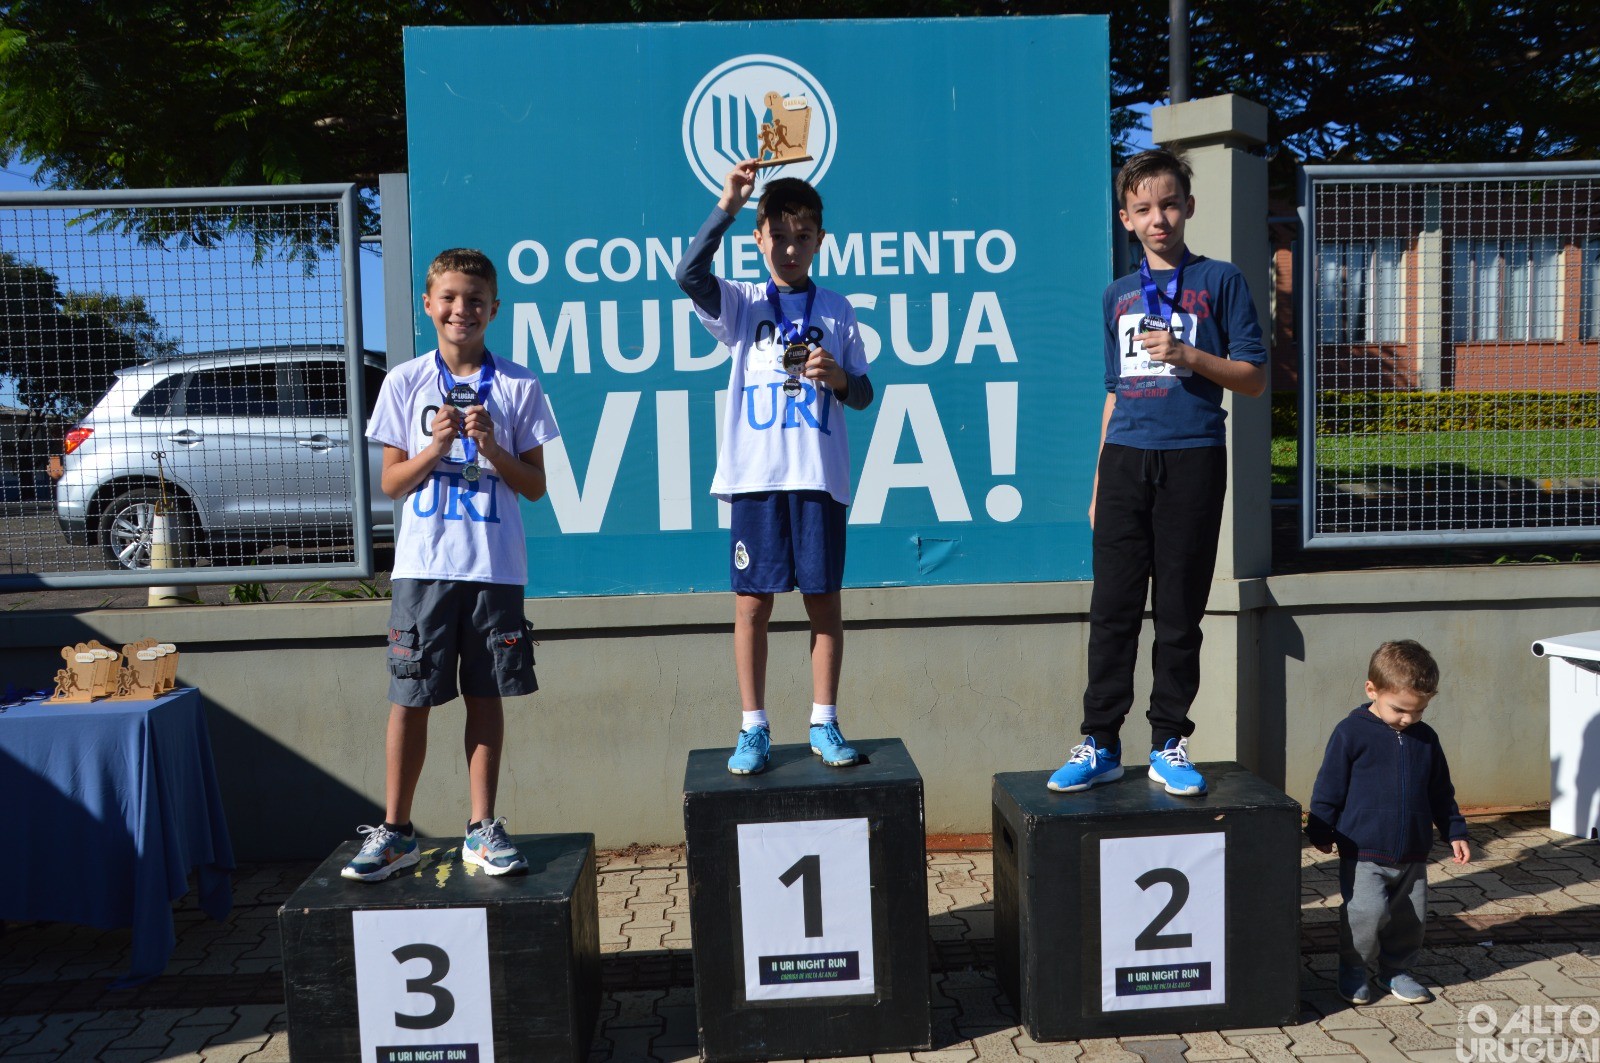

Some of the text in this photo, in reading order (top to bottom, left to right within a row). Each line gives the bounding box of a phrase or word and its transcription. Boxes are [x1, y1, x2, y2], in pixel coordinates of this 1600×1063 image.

[507, 229, 1017, 285] O CONEMENTO
[512, 299, 735, 374] MUD
[458, 392, 475, 400] LUGAR
[742, 381, 832, 437] URI
[1144, 388, 1168, 398] CENTER
[541, 381, 1023, 534] VIA!
[412, 471, 501, 524] URI
[778, 854, 824, 938] 1
[1134, 867, 1193, 951] 2
[391, 943, 455, 1030] 3
[780, 960, 794, 971] URI
[796, 959, 825, 970] NIGHT
[828, 957, 847, 969] RUN
[1135, 972, 1150, 982] URI
[1151, 970, 1179, 981] NIGHT
[1181, 968, 1200, 979] RUN
[397, 1051, 412, 1062] URI
[415, 1050, 444, 1061] NIGHT
[447, 1049, 466, 1060] RUN
